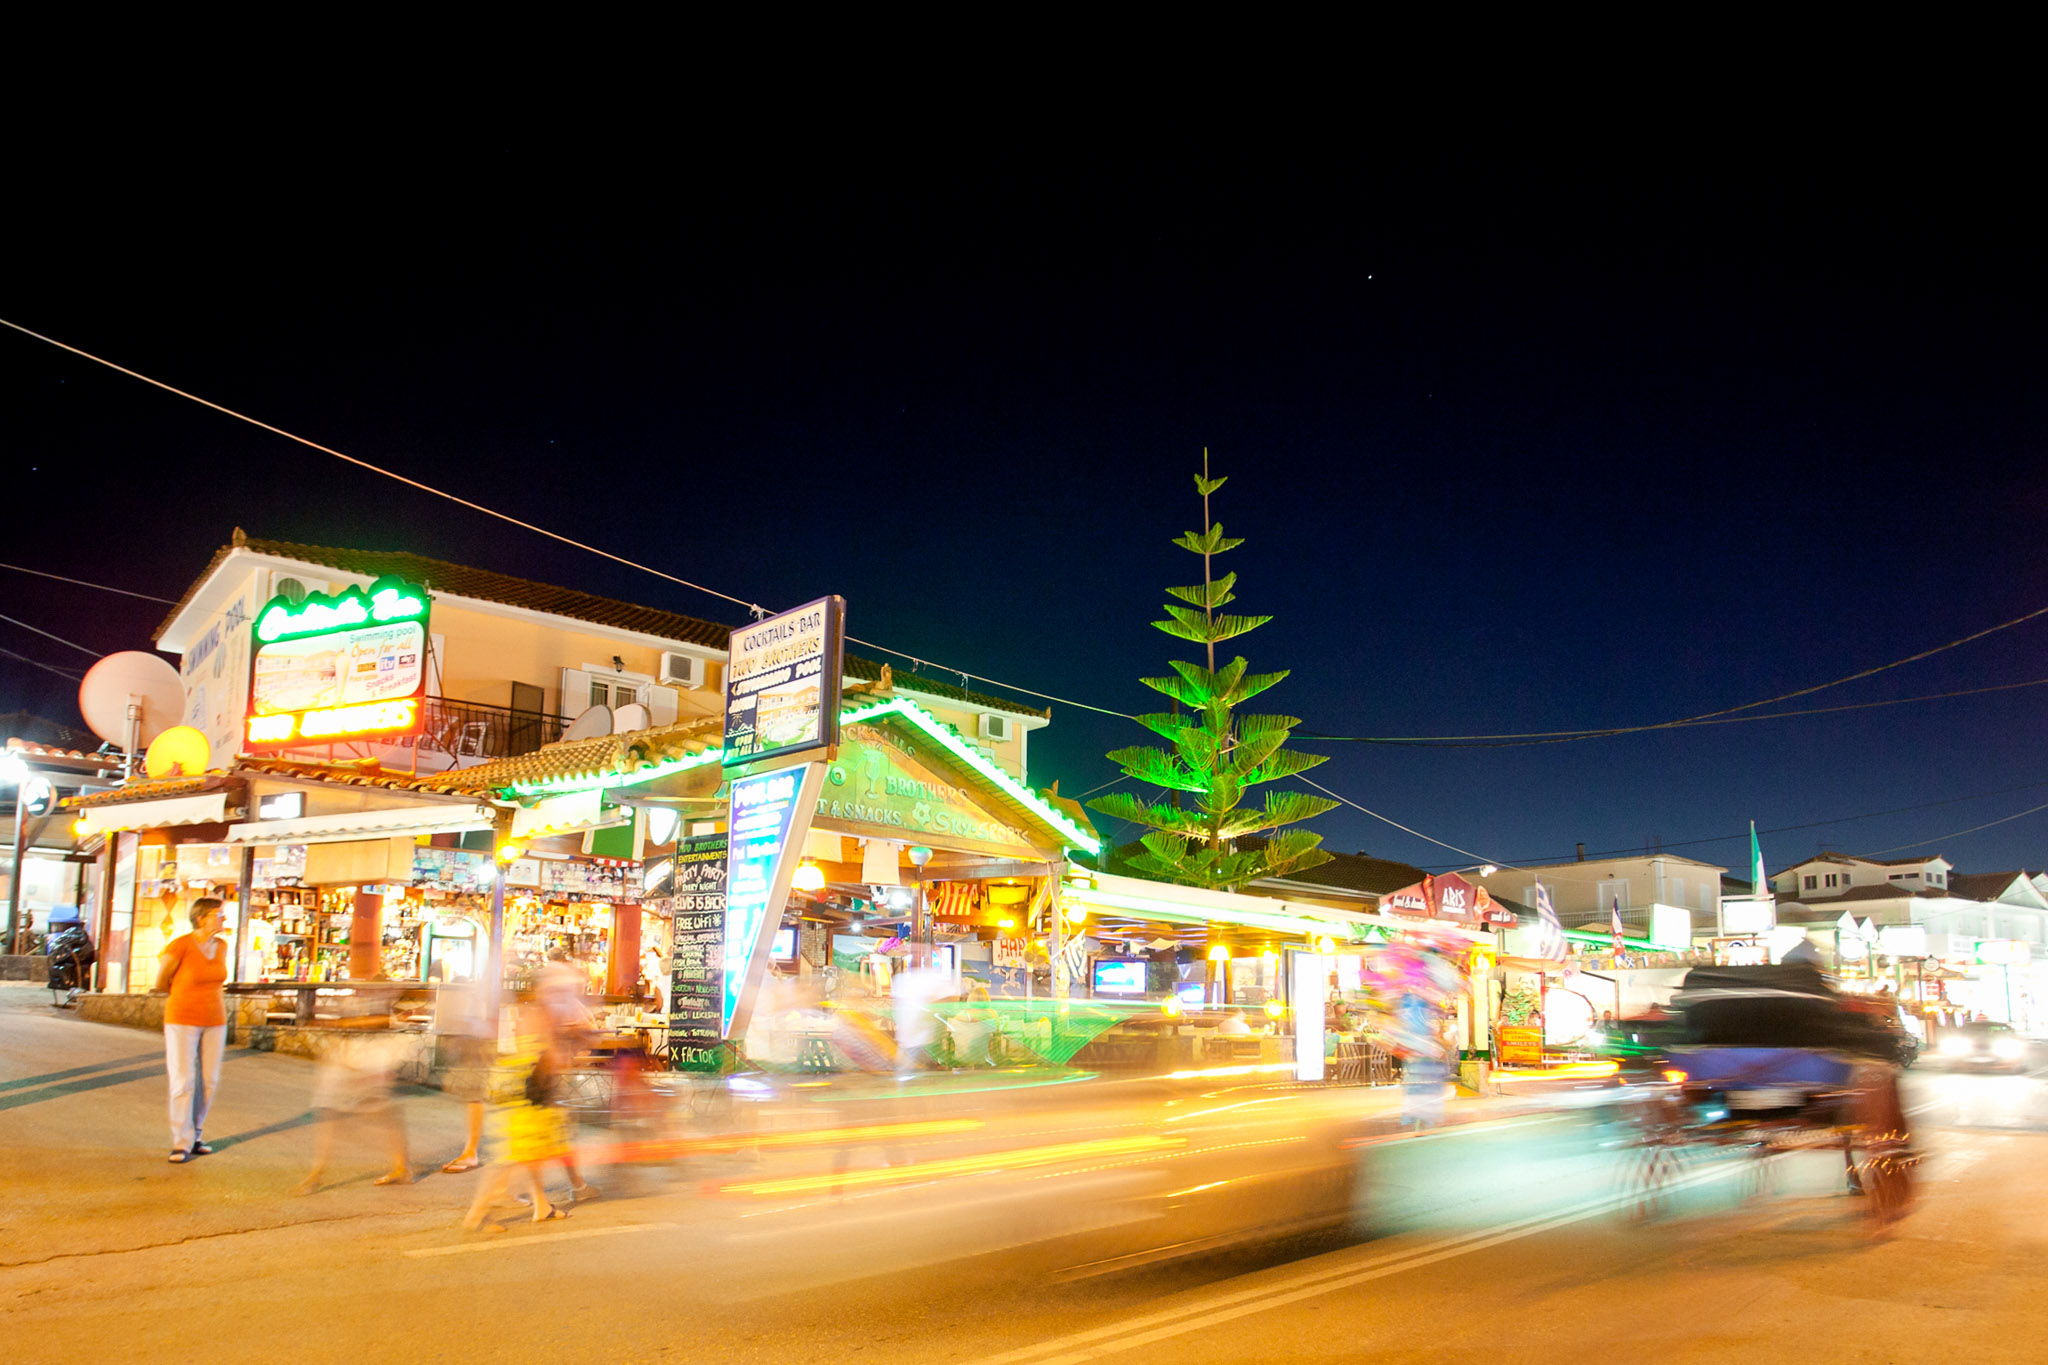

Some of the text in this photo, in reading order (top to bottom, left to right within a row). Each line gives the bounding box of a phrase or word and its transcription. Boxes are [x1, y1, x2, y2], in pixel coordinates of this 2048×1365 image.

[349, 624, 416, 644] Swimming pool
[743, 611, 821, 652] COCKTAILS BAR
[351, 636, 415, 663] Open for all
[732, 636, 820, 679] TWO BROTHERS
[795, 656, 822, 680] POOL
[365, 674, 394, 691] Snacks
[839, 724, 917, 757] OCKTAILS
[884, 775, 968, 807] BROTHERS
[830, 799, 841, 817] &
[694, 839, 728, 852] BROTHERS
[674, 864, 698, 888] PARTY
[700, 863, 728, 883] PARTY
[682, 881, 718, 891] EVERY NIGHT
[675, 895, 695, 910] ELVIS
[696, 896, 704, 910] IS
[704, 895, 727, 910] BACK
[1442, 886, 1466, 908] ARIS
[675, 917, 693, 930] FREE
[670, 1046, 716, 1066] X FACTOR
